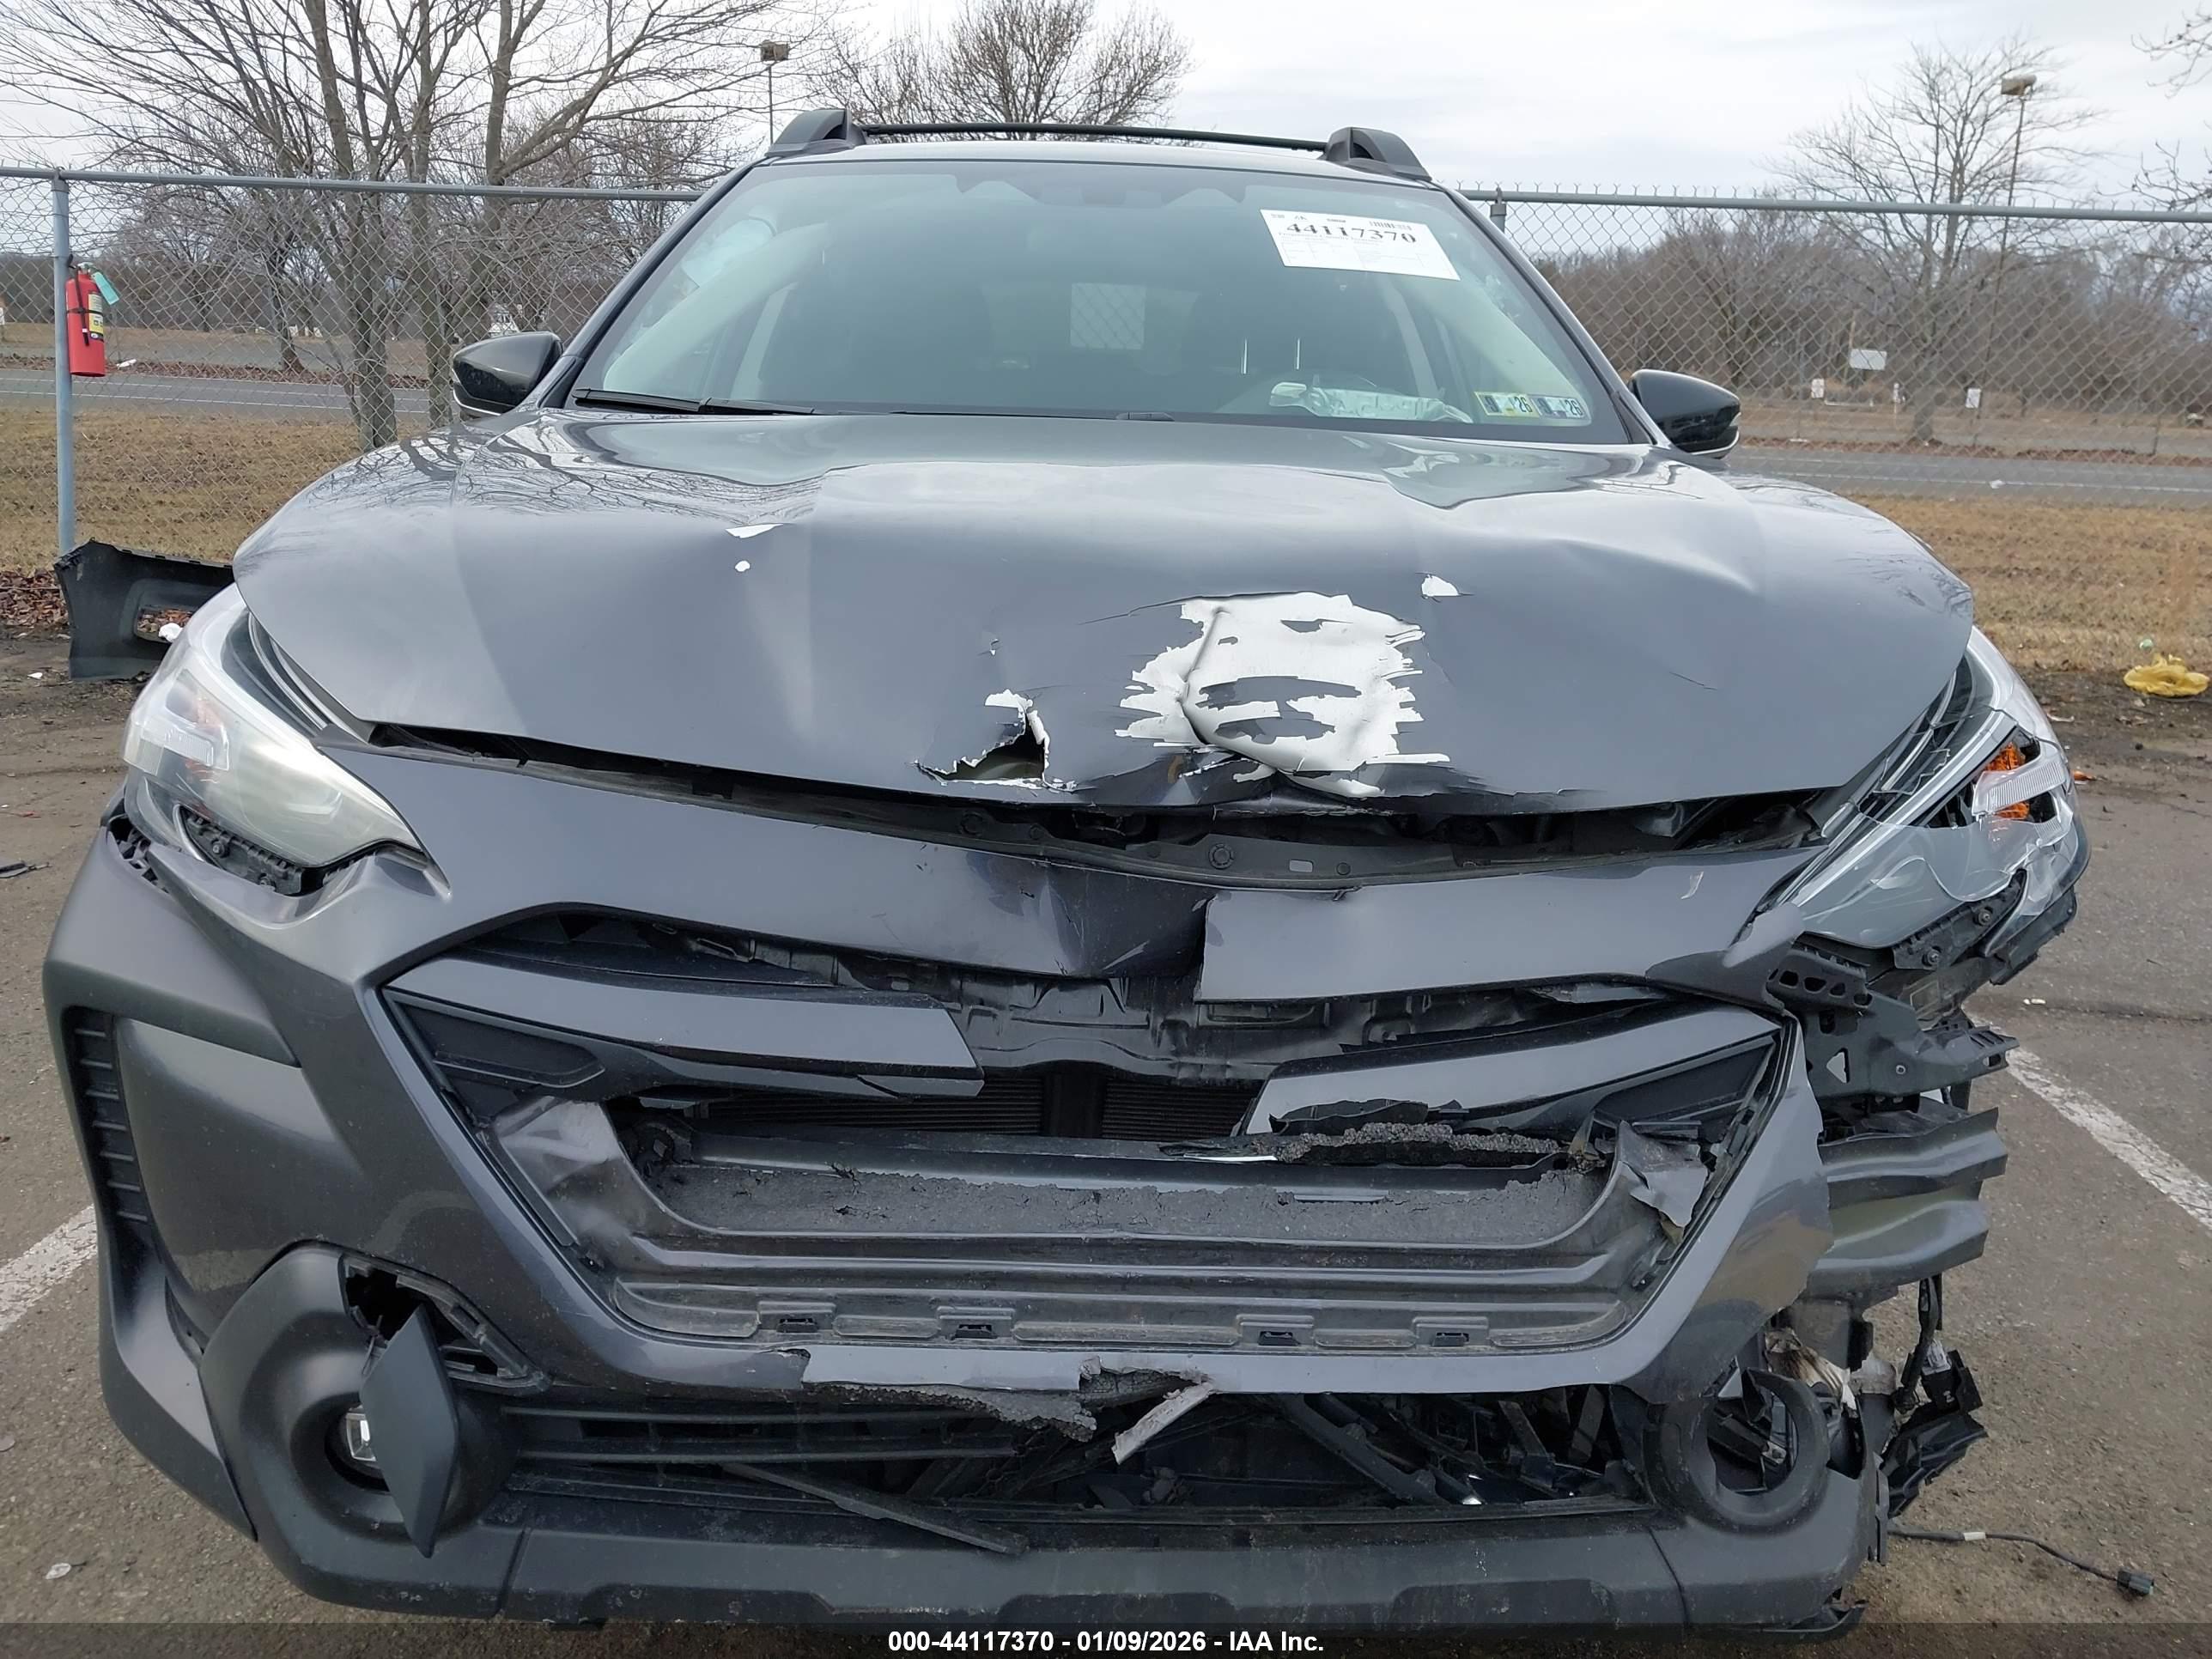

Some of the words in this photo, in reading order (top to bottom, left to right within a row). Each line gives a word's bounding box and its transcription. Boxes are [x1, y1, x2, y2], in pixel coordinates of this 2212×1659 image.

[1286, 222, 1417, 243] 44117370
[1514, 396, 1533, 413] 26
[1565, 399, 1583, 416] 26
